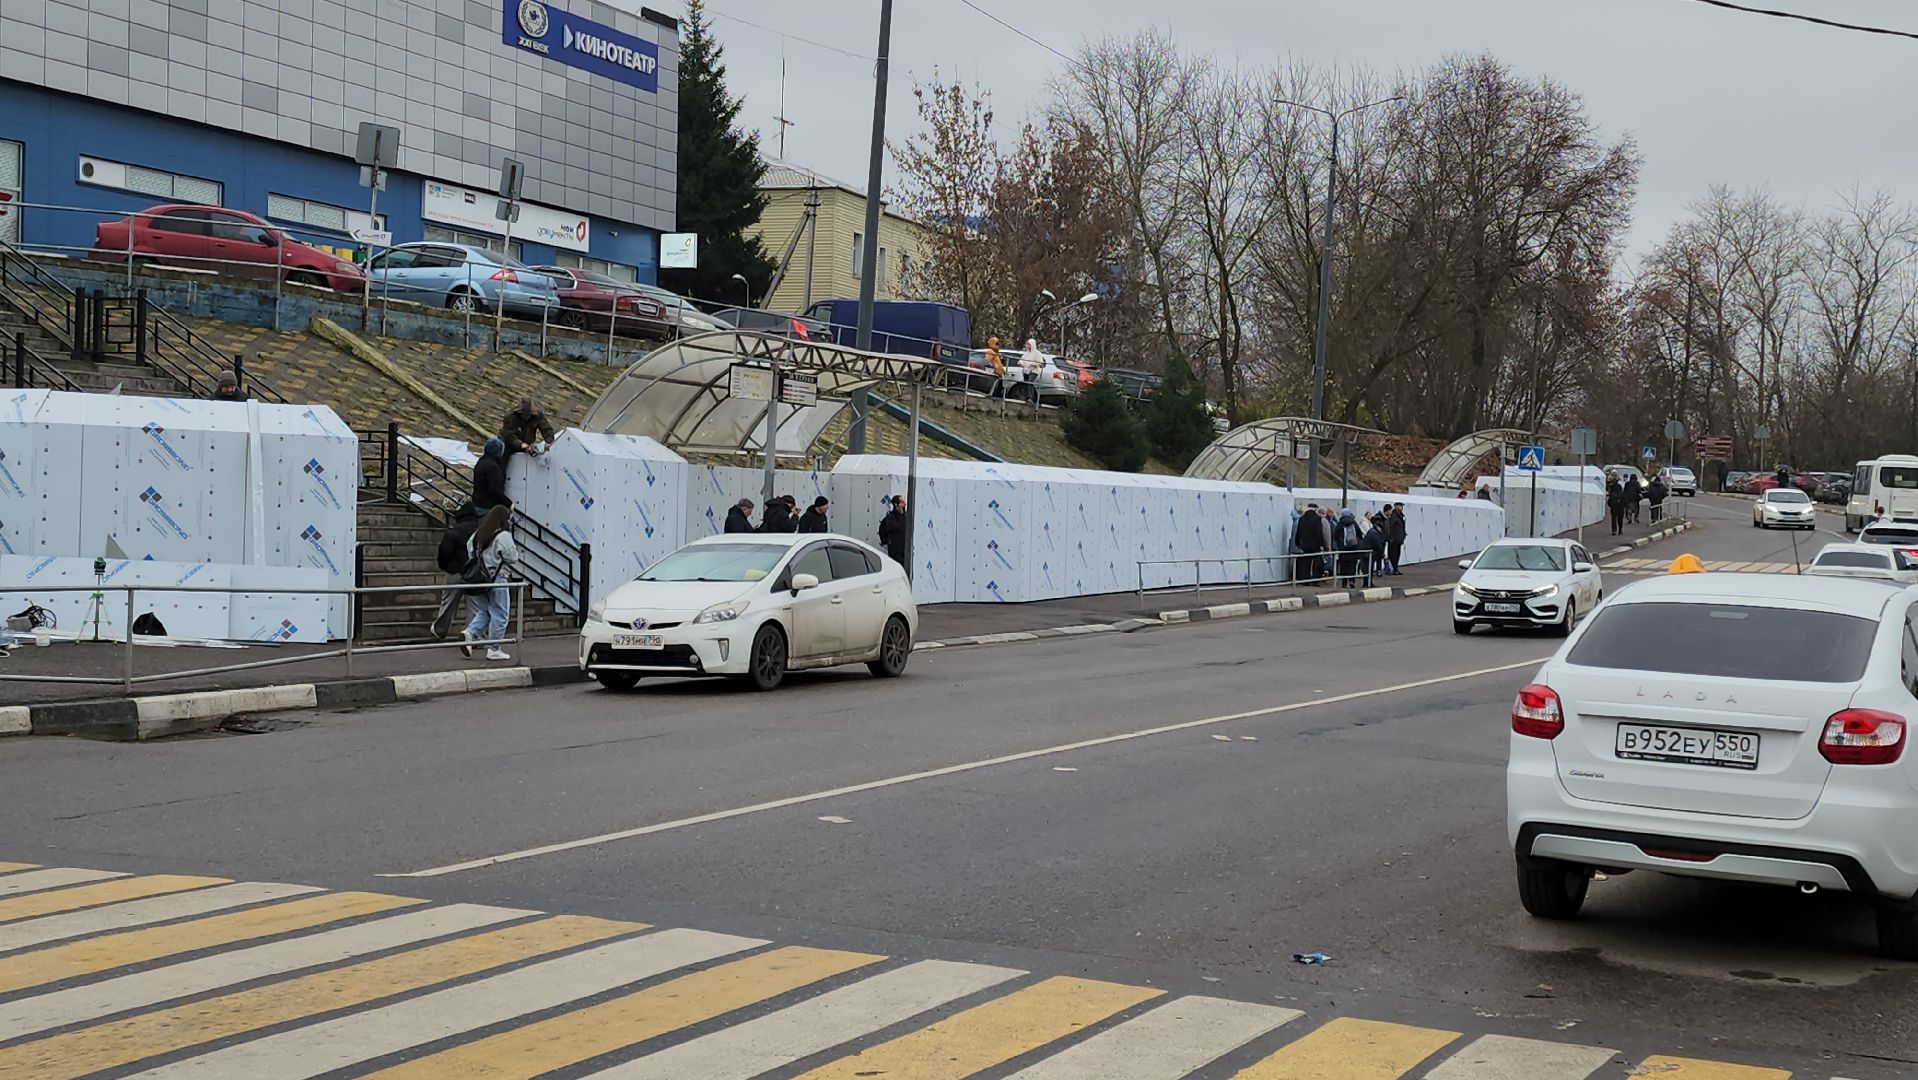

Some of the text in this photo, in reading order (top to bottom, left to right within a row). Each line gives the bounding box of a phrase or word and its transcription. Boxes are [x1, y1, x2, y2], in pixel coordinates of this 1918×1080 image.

[574, 31, 656, 75] КИНОТЕАТР
[1636, 686, 1737, 704] LADA
[1716, 734, 1751, 752] 550
[1723, 751, 1741, 759] RUS
